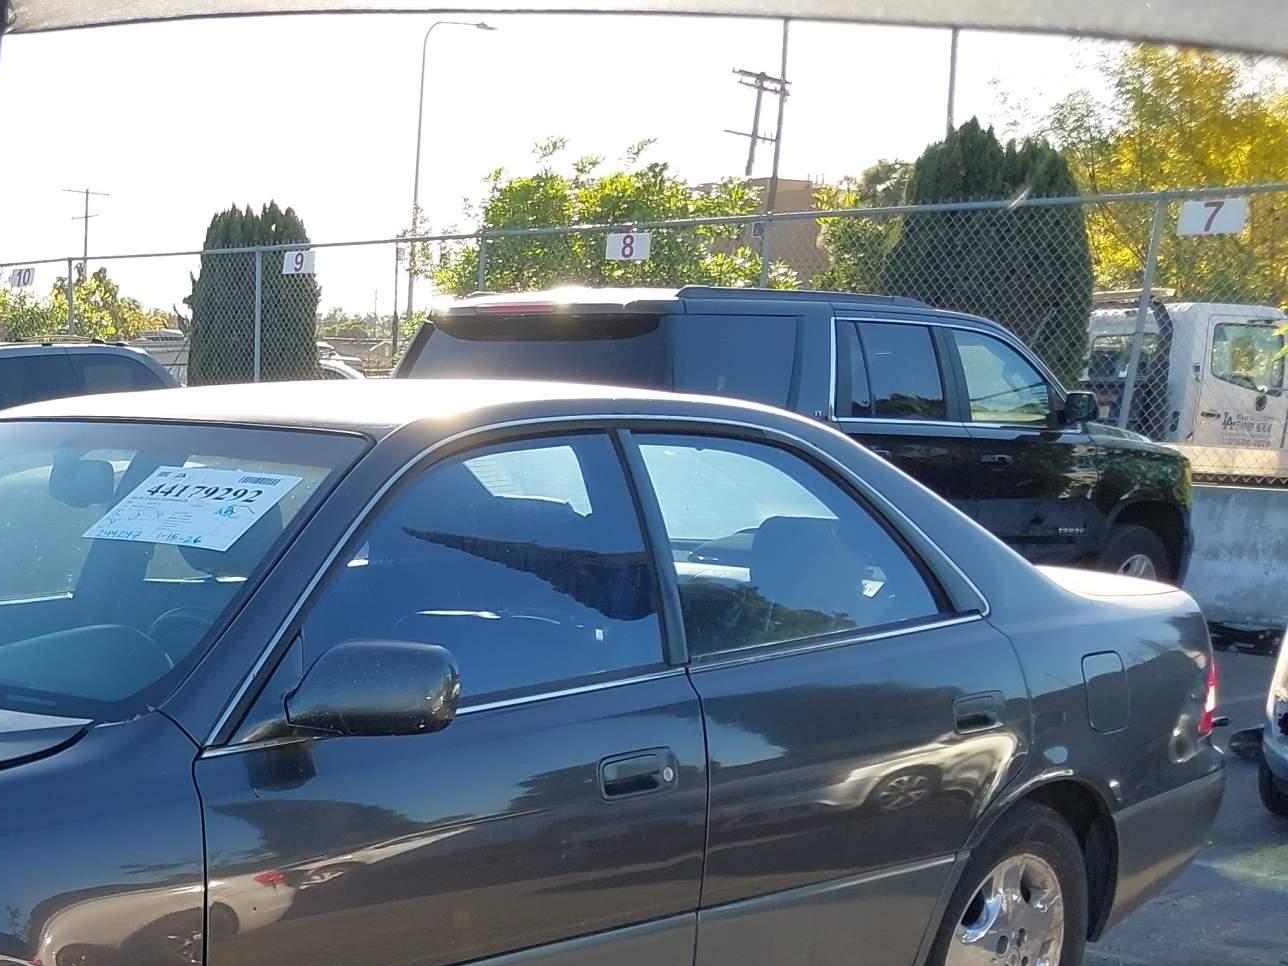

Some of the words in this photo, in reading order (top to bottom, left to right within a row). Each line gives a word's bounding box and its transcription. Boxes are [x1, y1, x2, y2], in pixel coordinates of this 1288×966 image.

[1203, 200, 1225, 232] 7
[621, 234, 634, 259] 8
[294, 252, 304, 272] 9
[16, 269, 31, 287] 10
[146, 483, 263, 503] 44179292
